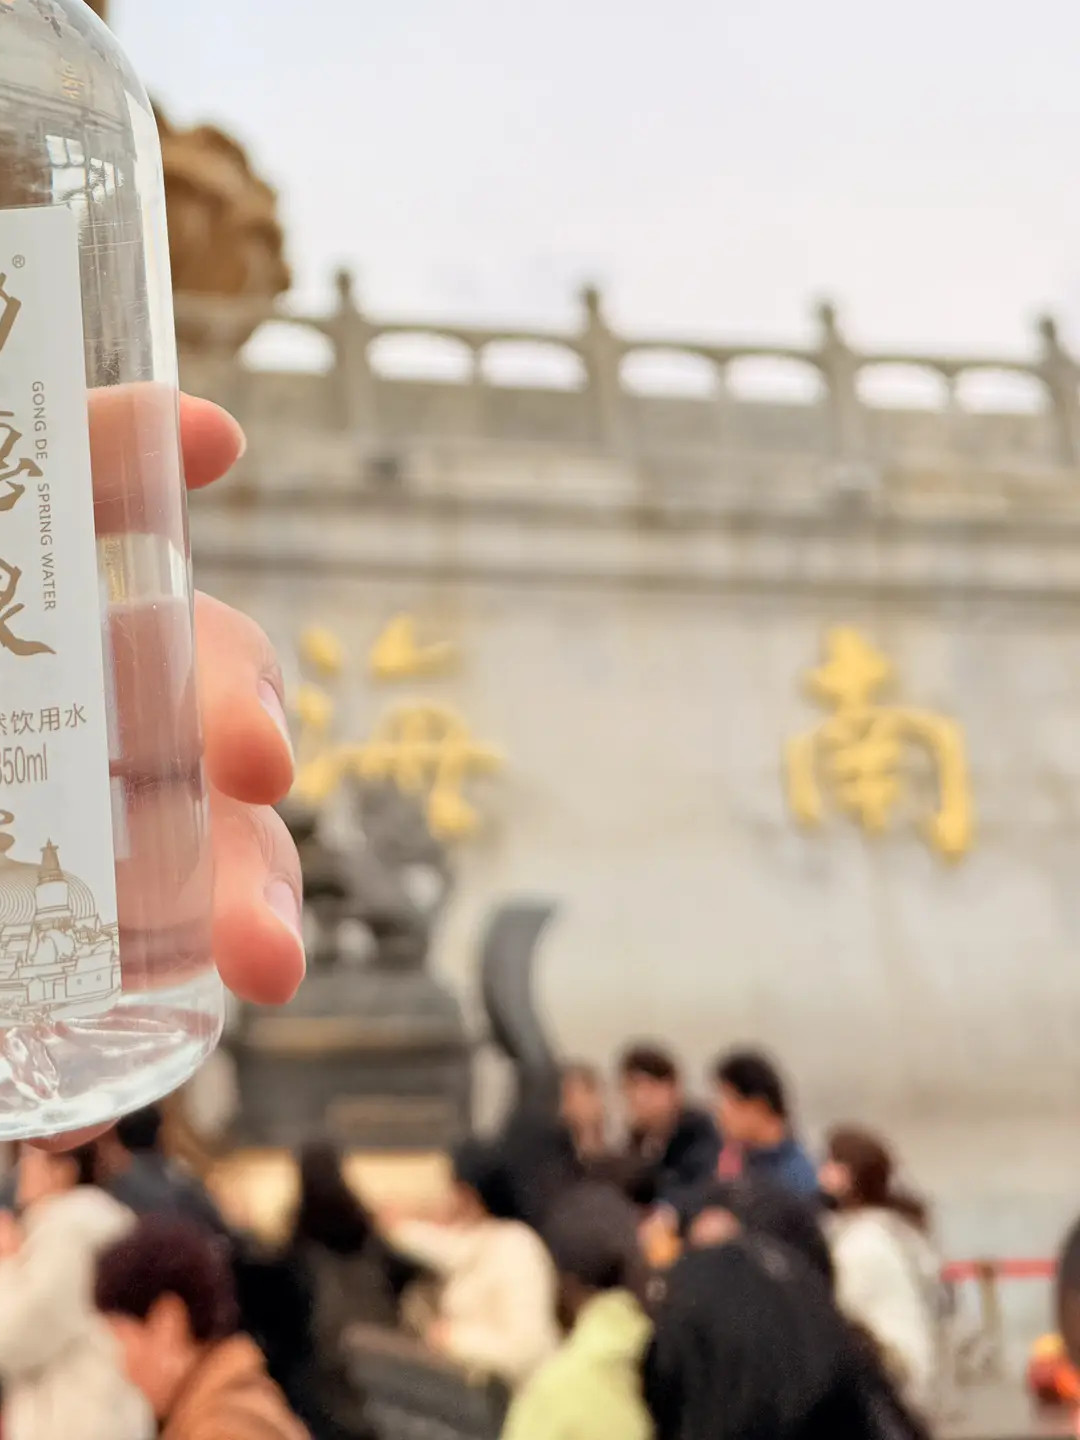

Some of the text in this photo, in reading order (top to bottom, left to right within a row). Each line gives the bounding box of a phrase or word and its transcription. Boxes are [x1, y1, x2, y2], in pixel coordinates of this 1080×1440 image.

[31, 380, 57, 612] GONG DE SPRING WATER
